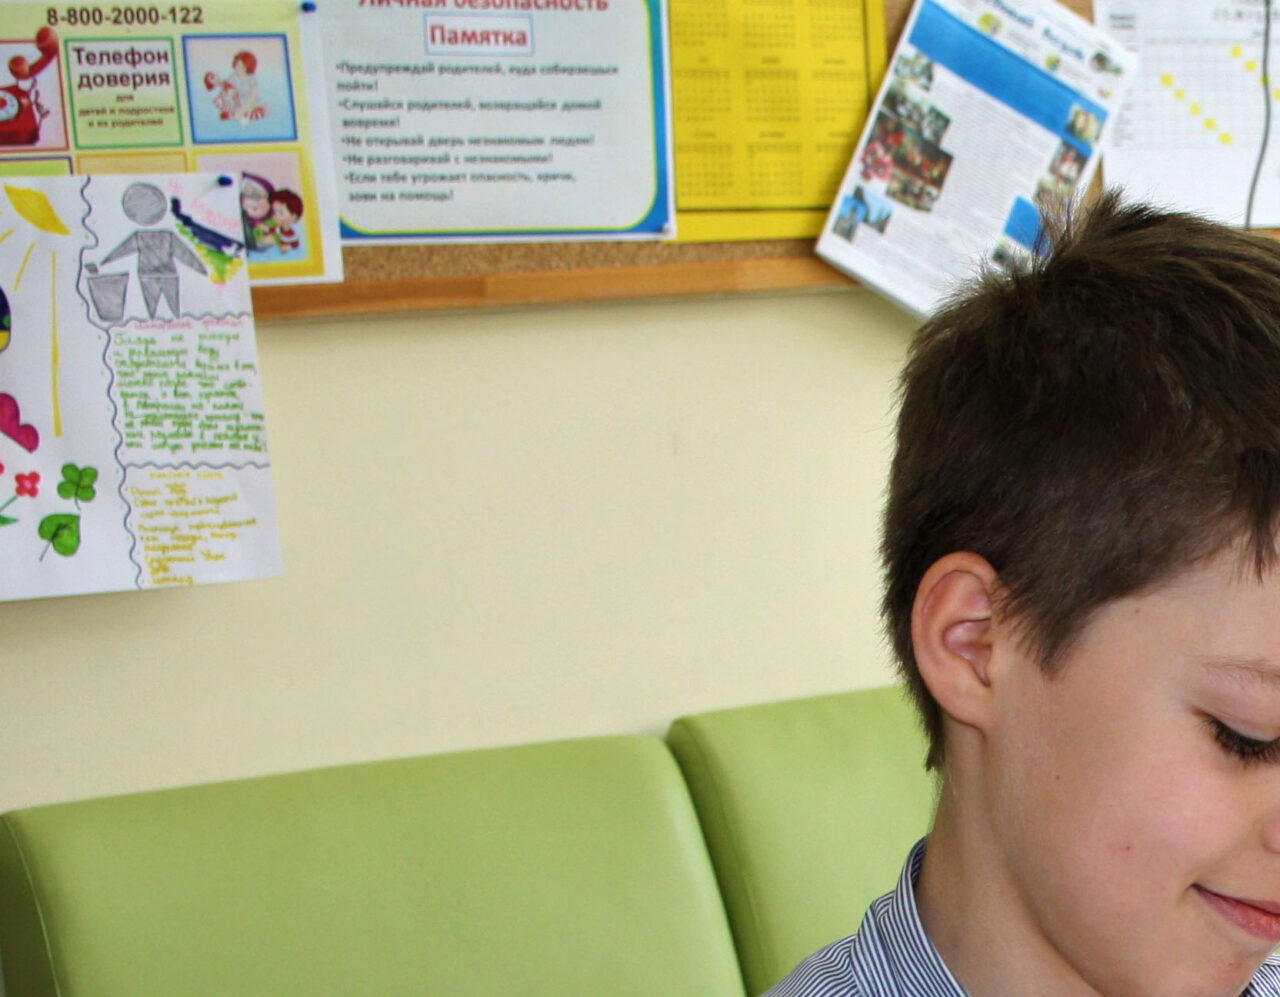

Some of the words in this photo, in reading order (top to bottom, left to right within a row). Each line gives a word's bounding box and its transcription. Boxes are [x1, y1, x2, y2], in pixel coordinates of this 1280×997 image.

[449, 0, 609, 11] безопасность
[47, 7, 204, 26] 8-800-2000-122
[429, 24, 528, 47] Памятка
[72, 46, 169, 69] Телефон
[341, 61, 434, 75] Предупреждай
[438, 62, 506, 76] родителей,
[508, 65, 537, 76] куда
[540, 62, 619, 76] собираешься
[78, 72, 170, 90] доверия
[336, 79, 379, 92] пойти!
[116, 93, 134, 102] для
[343, 97, 403, 112] Слушайся
[407, 98, 476, 112] родителей,
[562, 98, 602, 112] домой
[79, 107, 107, 117] детей
[118, 106, 175, 116] подростков
[111, 118, 163, 129] родителей
[342, 116, 400, 130] вовремя!
[365, 134, 425, 147] открывай
[428, 136, 465, 147] дверь
[348, 171, 377, 183] Если
[409, 173, 467, 185] угрожает
[398, 188, 453, 203] помощь!
